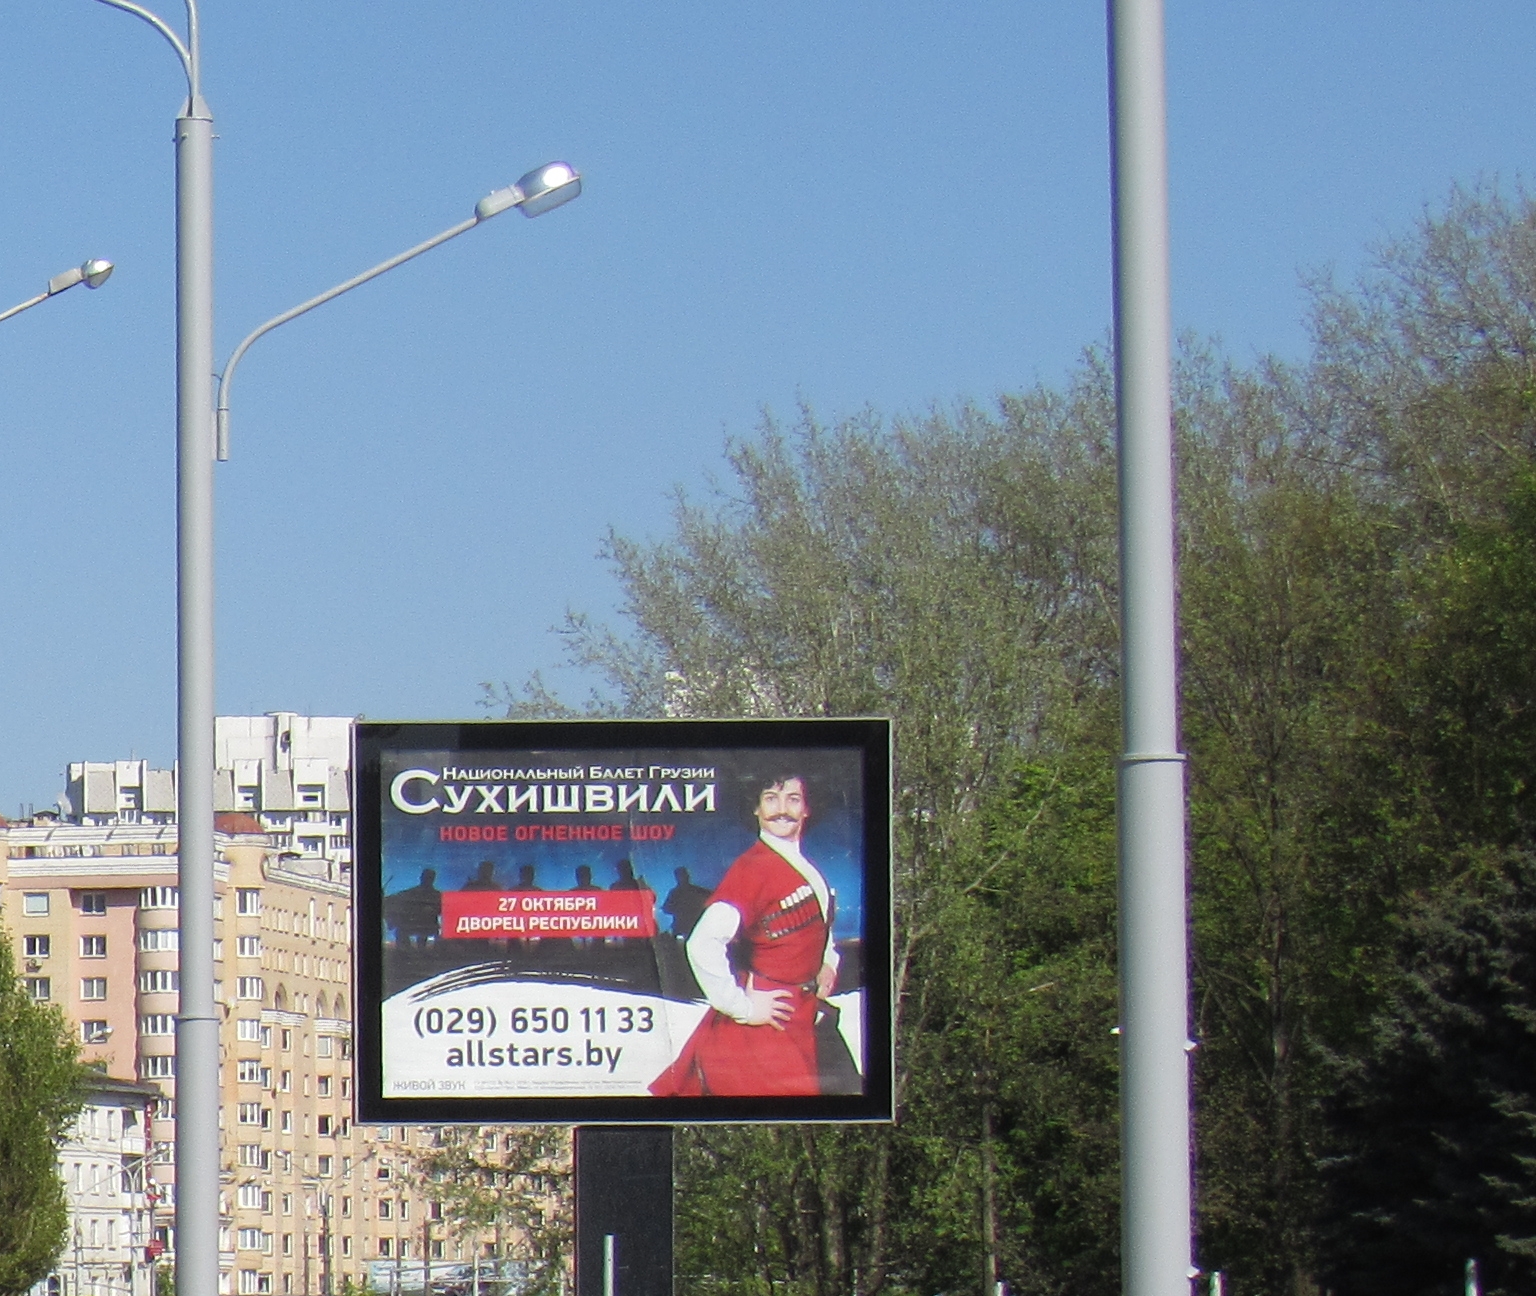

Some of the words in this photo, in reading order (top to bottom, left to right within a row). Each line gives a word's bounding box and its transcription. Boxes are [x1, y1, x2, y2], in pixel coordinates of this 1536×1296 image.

[439, 825, 508, 841] НОВОЕ
[514, 824, 624, 841] ОГНЕННОЕ
[629, 824, 676, 841] ШОУ
[498, 897, 518, 912] 27
[521, 897, 596, 911] ОКТЯБРЯ
[456, 916, 525, 933] ДВОРЕЦ
[529, 915, 639, 931] РЕСПУБЛИКИ
[414, 1006, 497, 1039] (029)
[510, 1007, 569, 1034] 650
[579, 1007, 607, 1033] 11
[617, 1006, 655, 1033] 33
[446, 1039, 623, 1073] allstars.by
[393, 1080, 436, 1091] ЖИВОЙ
[438, 1081, 466, 1091] ЗВУК
